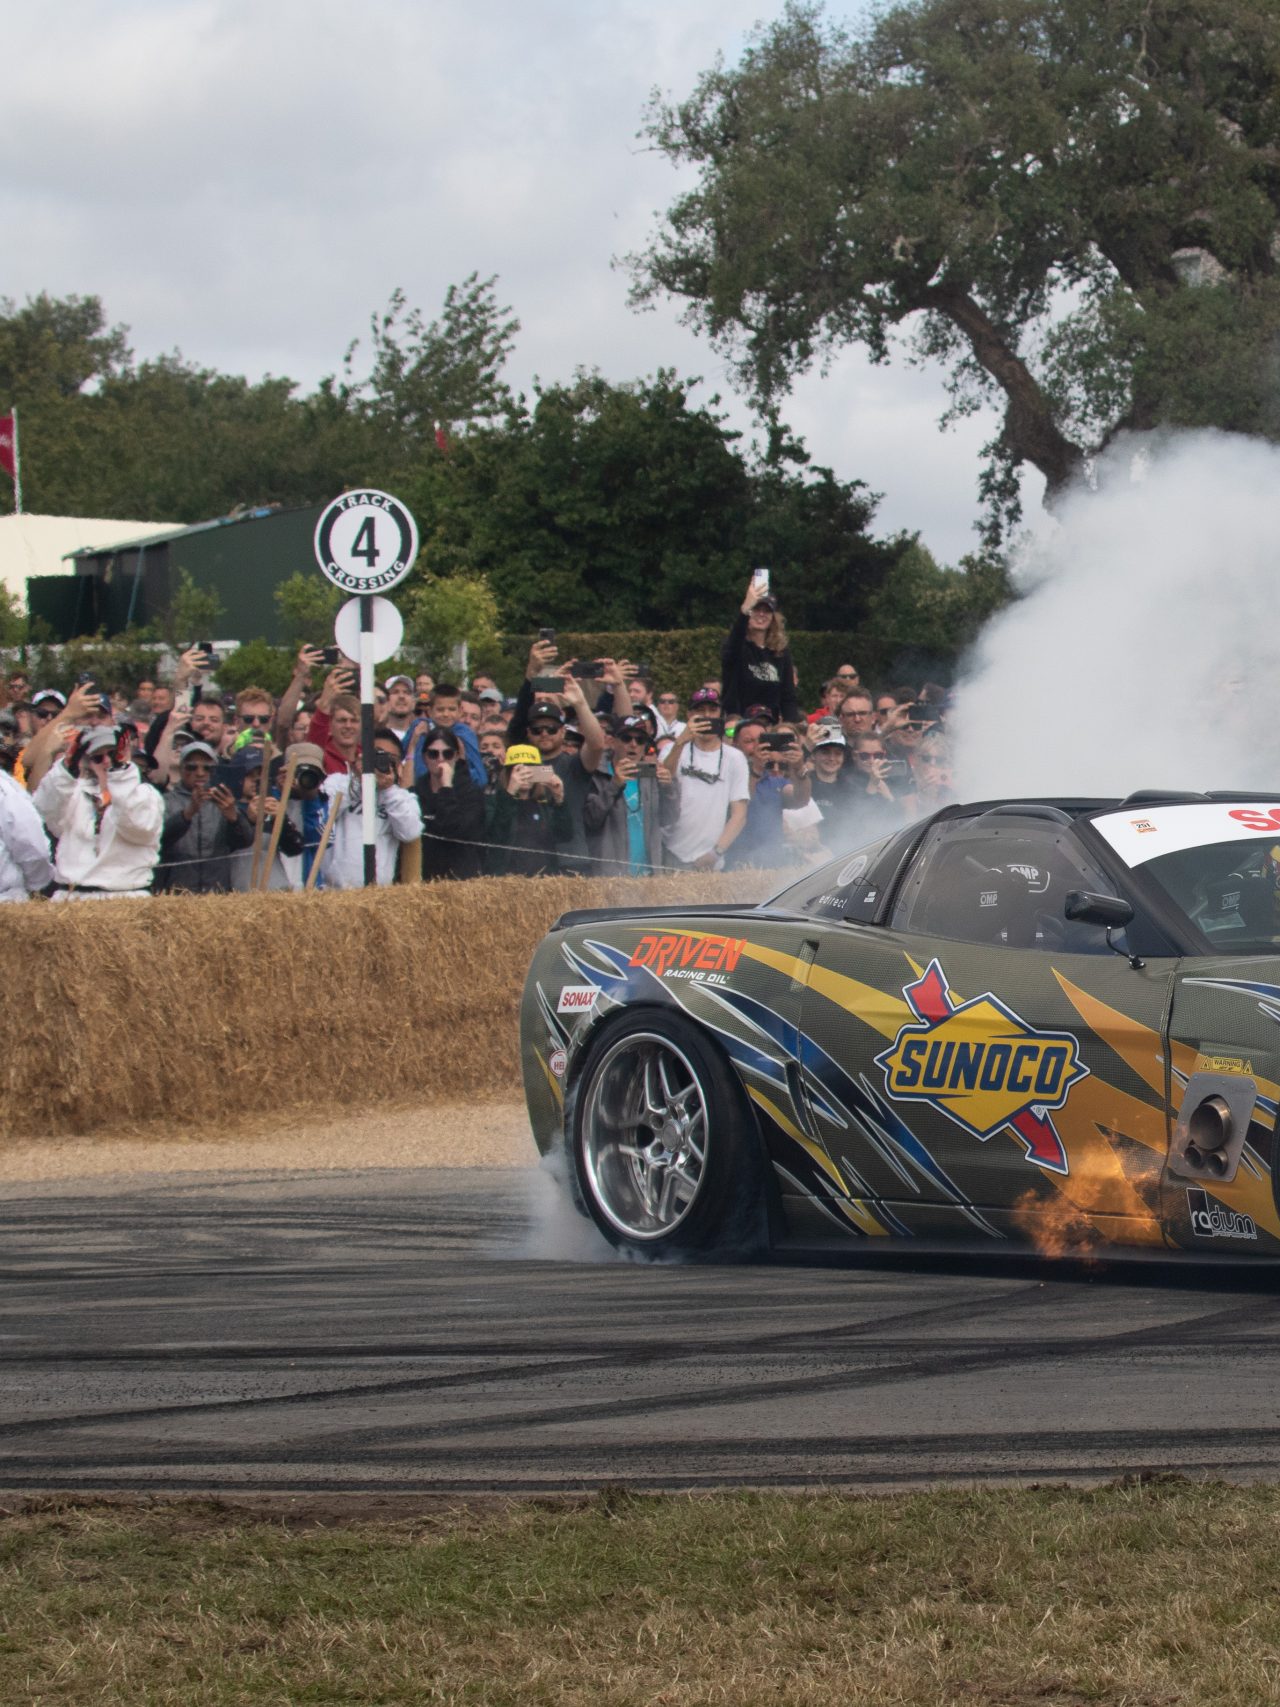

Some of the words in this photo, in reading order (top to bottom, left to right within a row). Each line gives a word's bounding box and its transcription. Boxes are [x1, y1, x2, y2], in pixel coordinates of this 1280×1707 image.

[336, 495, 394, 512] TRACK
[351, 516, 380, 567] 4
[327, 560, 405, 589] CROSSING
[980, 893, 998, 905] OMP
[628, 935, 747, 976] DRIVEN
[663, 969, 705, 981] RACING
[708, 974, 727, 985] OIL
[562, 991, 596, 1007] SONAX
[895, 1039, 1068, 1095] SUNOCO
[1191, 1204, 1256, 1234] radium
